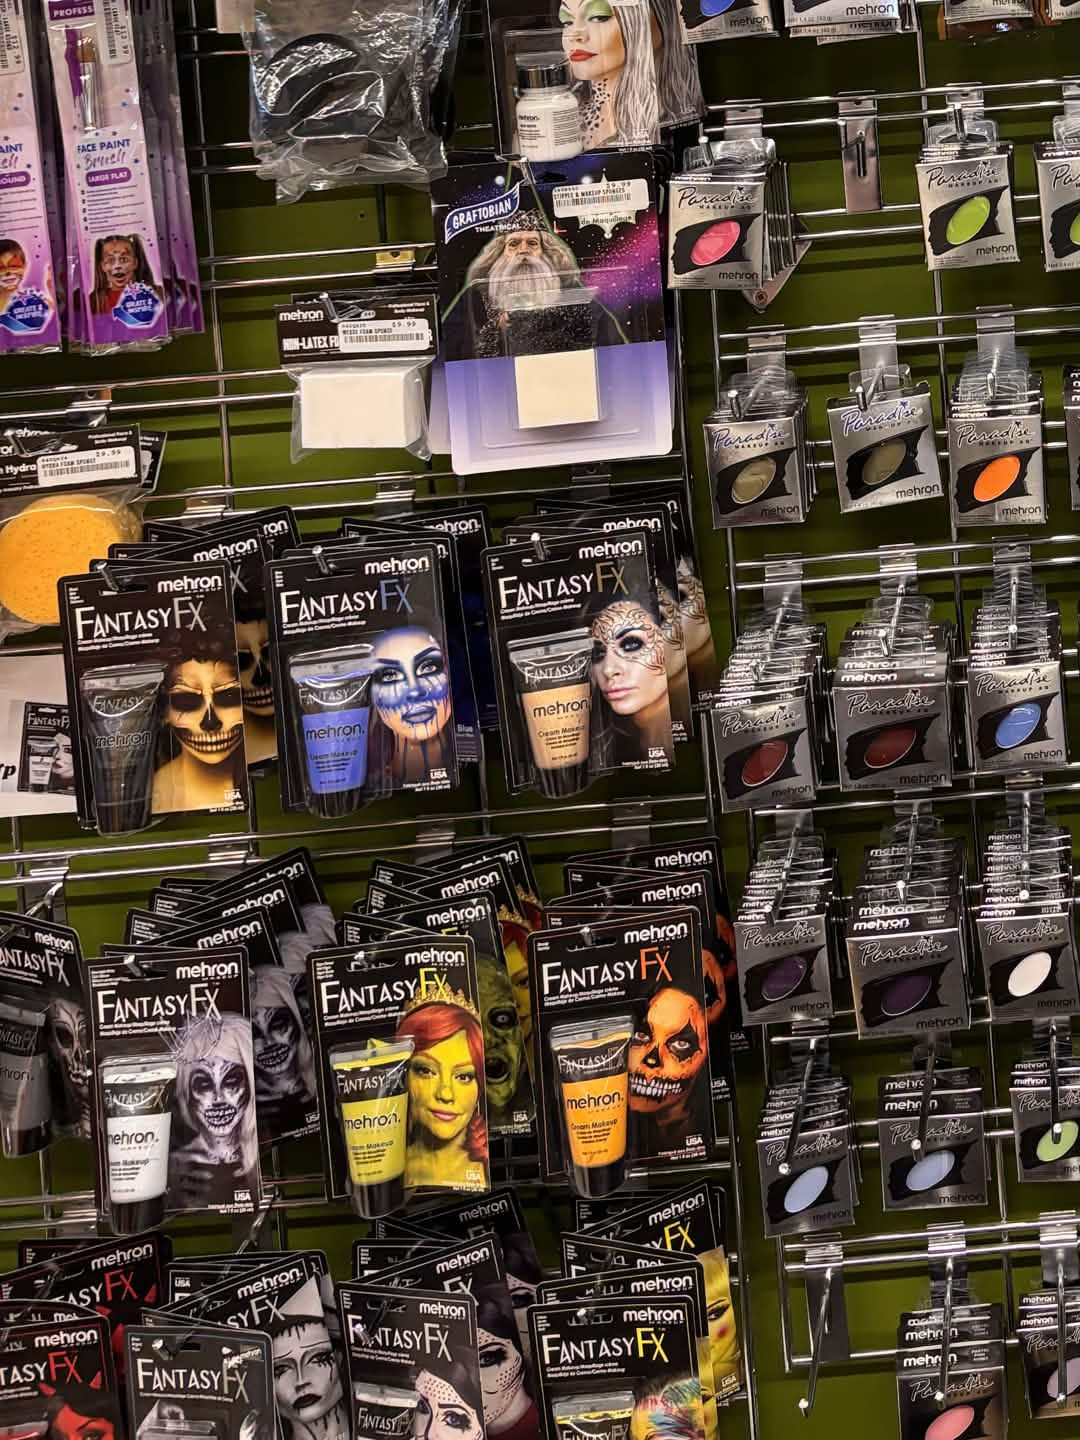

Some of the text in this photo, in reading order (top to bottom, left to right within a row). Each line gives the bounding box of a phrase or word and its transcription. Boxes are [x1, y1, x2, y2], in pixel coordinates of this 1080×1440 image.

[77, 138, 131, 154] FACE PAINT
[452, 197, 514, 229] GRAFTOBIAN
[279, 309, 324, 322] mehron
[6, 463, 37, 476] Hydra
[895, 485, 940, 501] mehron
[578, 539, 643, 560] mehron
[364, 556, 430, 576] mehron
[157, 576, 223, 594] mehron
[305, 722, 363, 741] mehron
[648, 747, 665, 758] USA
[430, 769, 448, 779] USA
[900, 772, 948, 786] mehron
[441, 869, 500, 899] mehron
[624, 921, 688, 945] mehron
[404, 949, 465, 965] mehron
[176, 961, 239, 980] mehron
[566, 1090, 621, 1111] mehron
[685, 1136, 703, 1146] USA
[233, 1191, 251, 1201] USA
[648, 1192, 705, 1226] mehron
[90, 1242, 154, 1271] mehron
[236, 1266, 302, 1299] mehron
[630, 1274, 694, 1295] mehron
[419, 1301, 466, 1318] mehron
[34, 1329, 99, 1348] mehron
